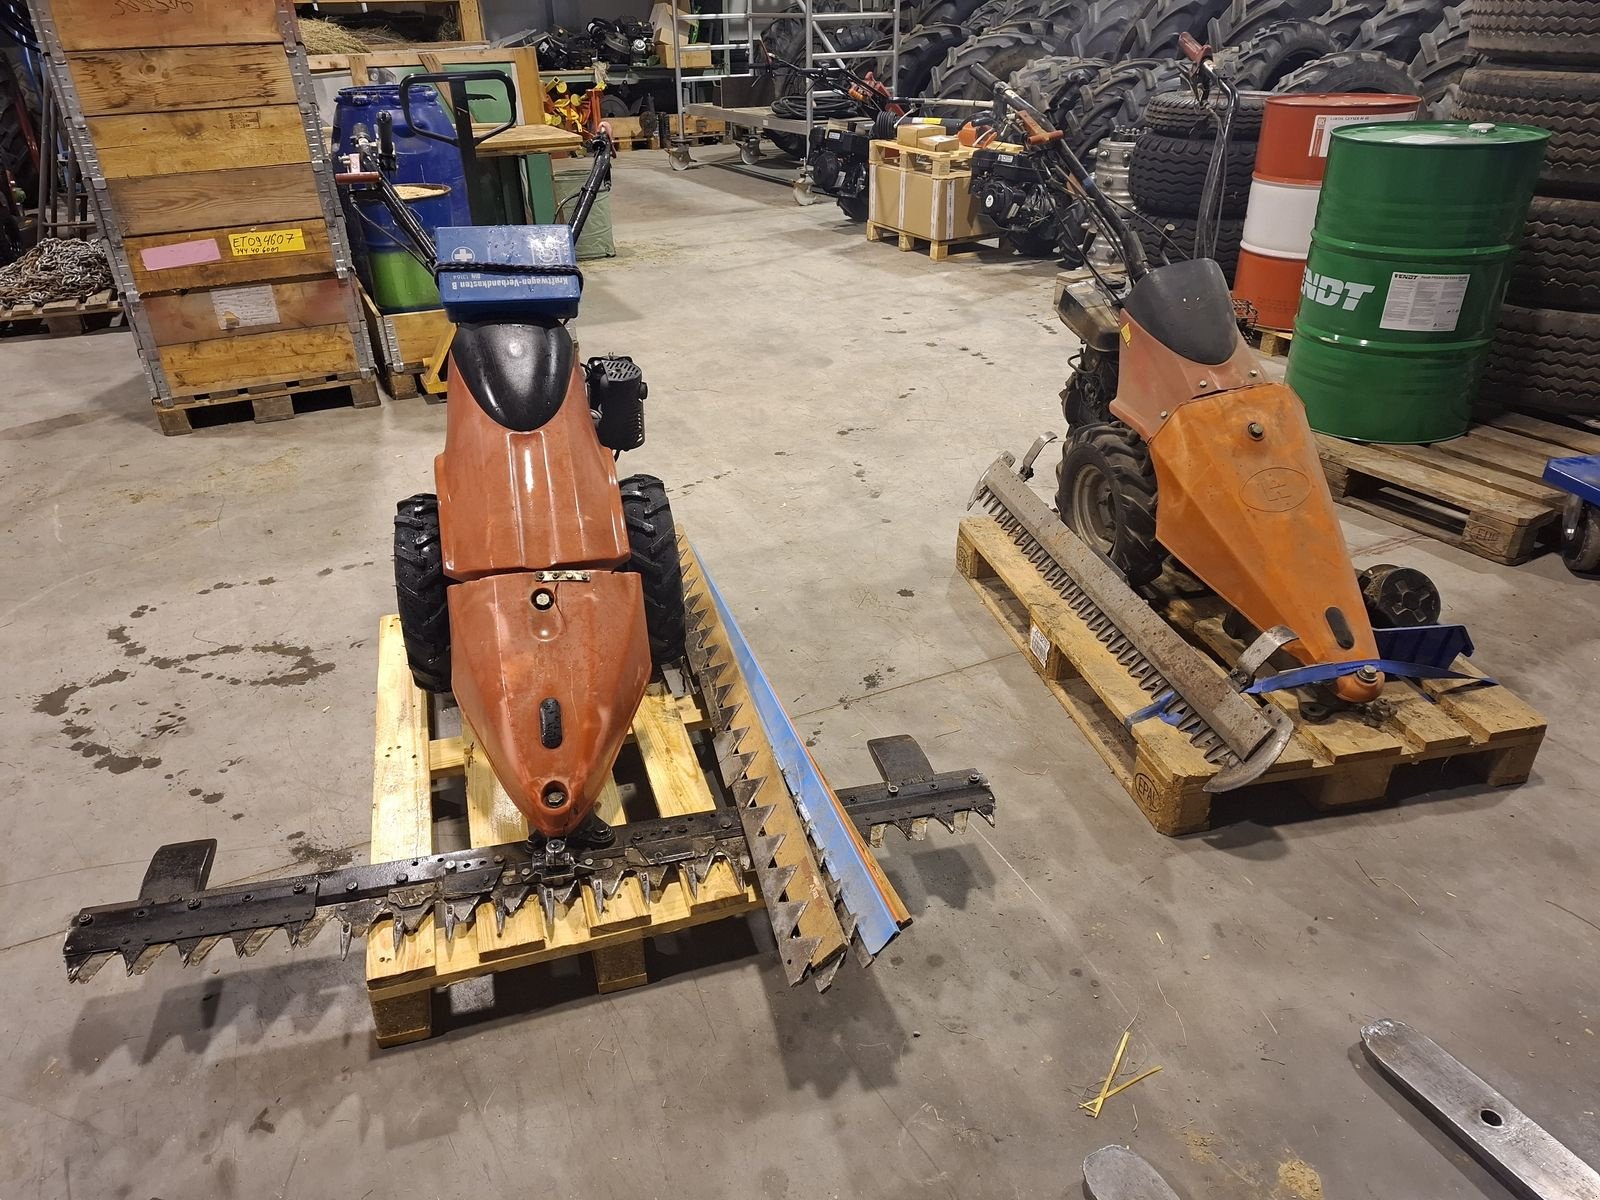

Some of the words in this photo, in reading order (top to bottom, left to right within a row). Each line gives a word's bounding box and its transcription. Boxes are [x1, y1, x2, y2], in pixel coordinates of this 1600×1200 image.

[451, 281, 458, 290] B
[460, 276, 569, 289] Kraftwagen-Verbandkasten
[1301, 265, 1376, 311] NDT
